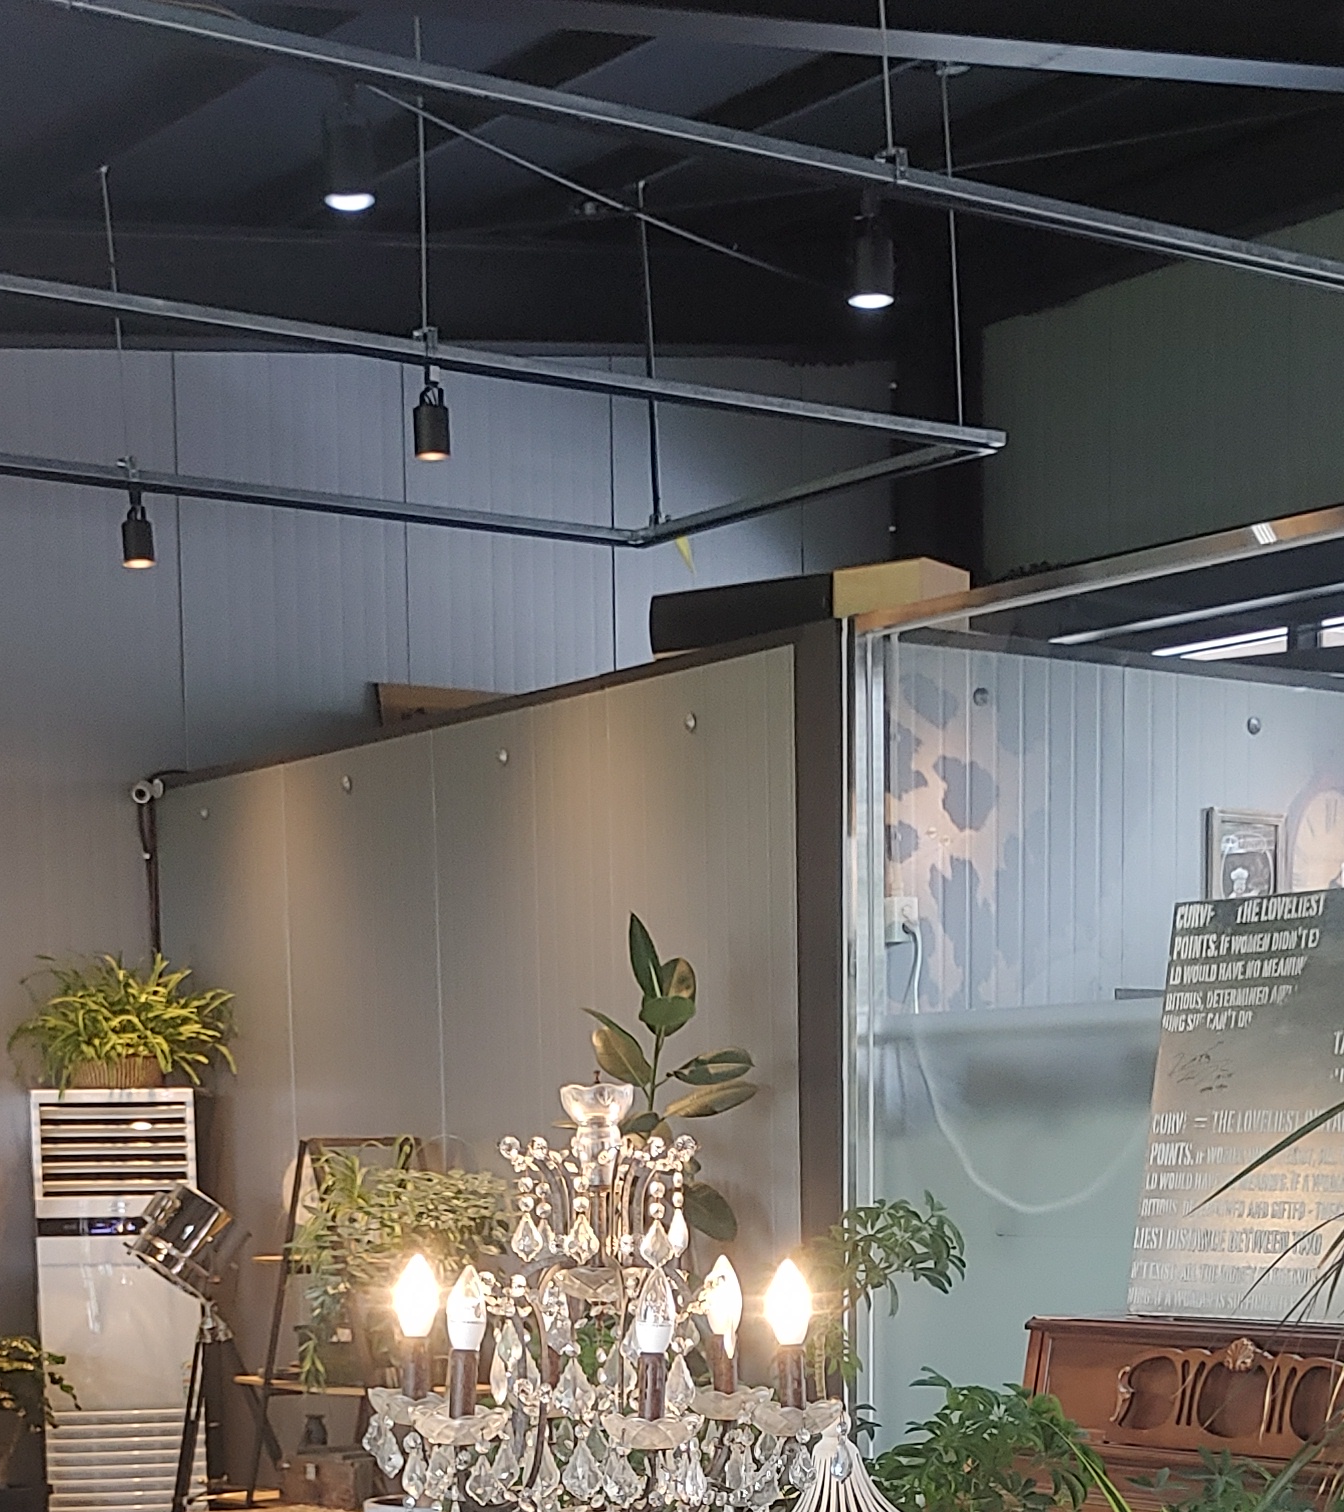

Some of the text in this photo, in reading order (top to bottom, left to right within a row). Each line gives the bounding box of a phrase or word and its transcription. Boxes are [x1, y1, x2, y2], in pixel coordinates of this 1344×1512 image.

[1236, 898, 1260, 924] THE
[1260, 893, 1327, 921] LOVELIEST
[1172, 933, 1218, 960] POINTS.
[1219, 934, 1230, 956] IF
[1231, 931, 1270, 955] WOMEN
[1271, 926, 1306, 951] DIDN'T
[1183, 963, 1218, 984] WOULD
[1218, 960, 1245, 981] HAVE
[1245, 959, 1261, 979] NO
[1205, 986, 1269, 1009] DETERMINED
[1206, 1009, 1237, 1031] CAN'T
[1212, 1110, 1235, 1133] THE
[1236, 1109, 1301, 1133] LOVELIEST
[1149, 1142, 1194, 1166] POINTS.
[1159, 1172, 1193, 1191] WOULD
[1133, 1226, 1163, 1249] LIEST
